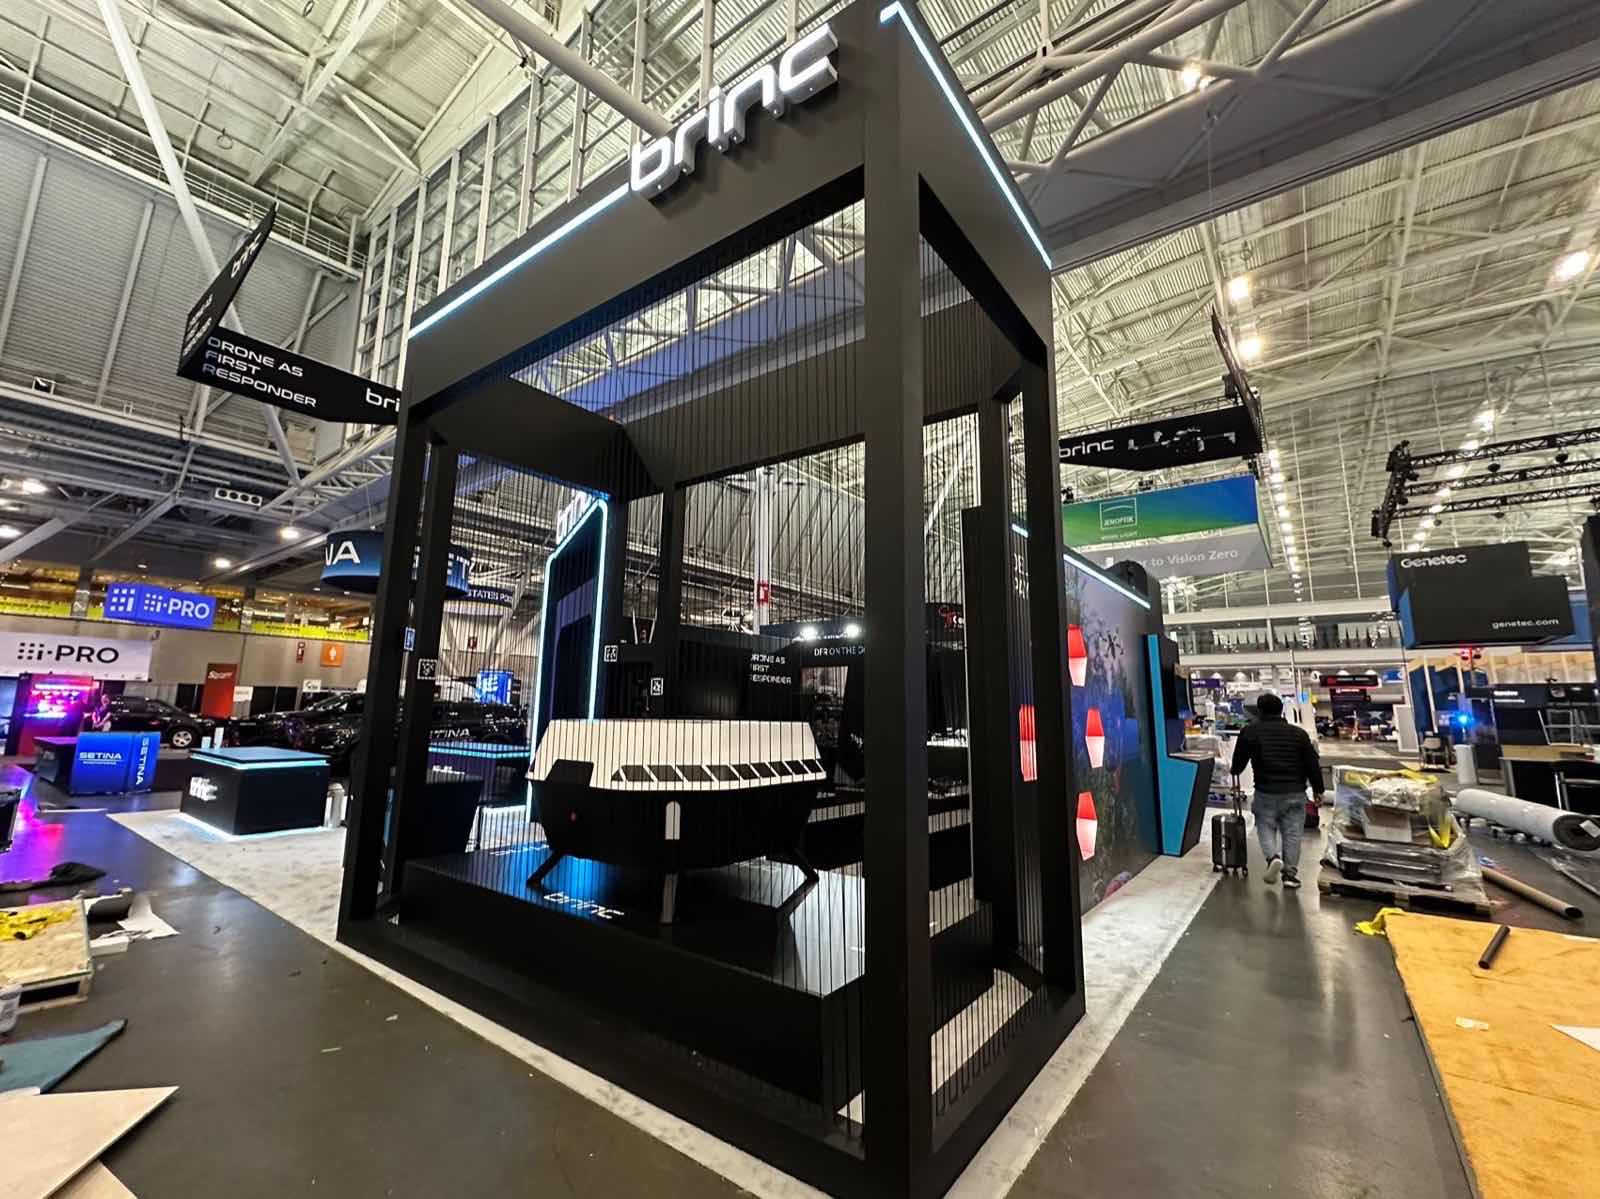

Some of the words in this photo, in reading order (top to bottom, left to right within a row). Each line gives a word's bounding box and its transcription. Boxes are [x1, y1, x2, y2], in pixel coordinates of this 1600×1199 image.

[631, 23, 838, 198] brinc
[205, 350, 261, 375] FIRST
[207, 336, 275, 368] DRONE
[278, 363, 304, 377] AS
[202, 363, 317, 408] RESPONDER
[365, 387, 400, 413] bri
[1059, 439, 1114, 459] brinc
[1167, 552, 1205, 565] Vision
[1208, 549, 1238, 560] Zero
[1401, 553, 1468, 568] Genetec
[1492, 618, 1560, 630] genetec.com
[135, 737, 150, 785] SETINA
